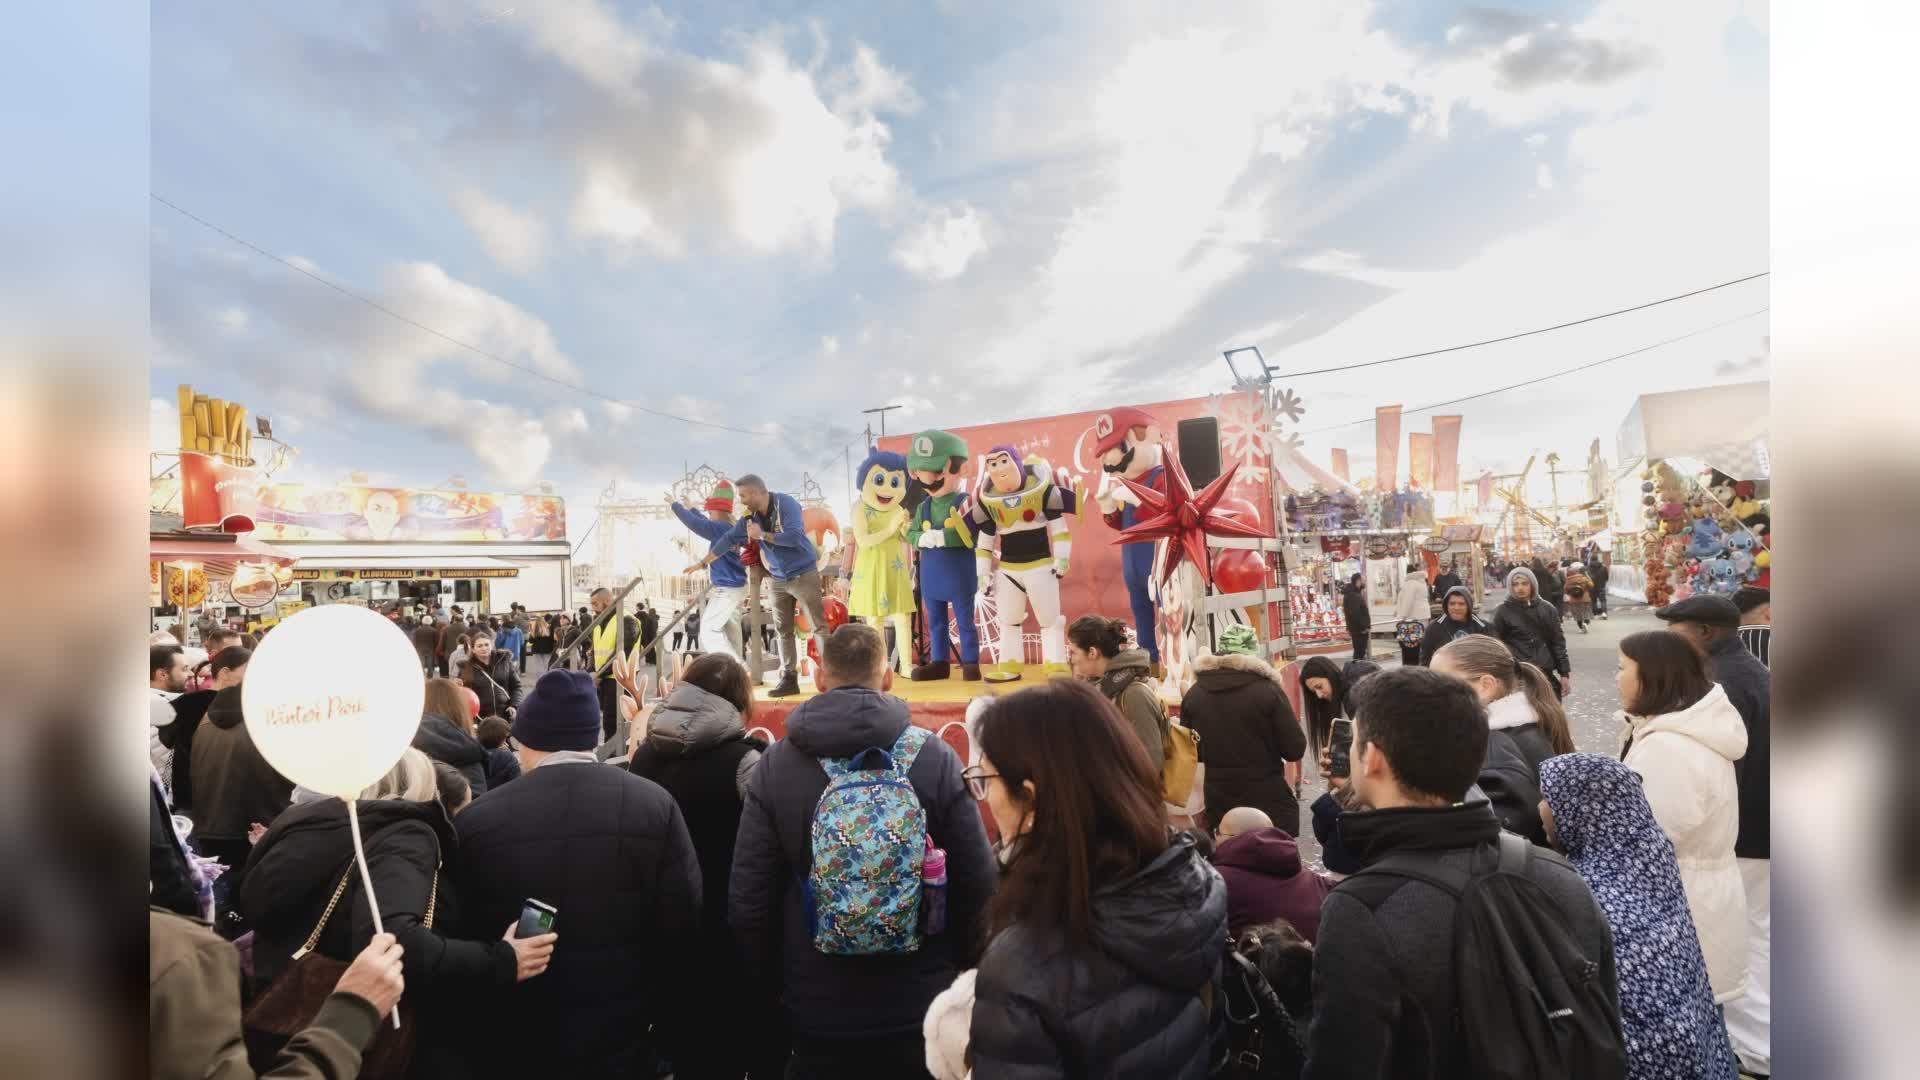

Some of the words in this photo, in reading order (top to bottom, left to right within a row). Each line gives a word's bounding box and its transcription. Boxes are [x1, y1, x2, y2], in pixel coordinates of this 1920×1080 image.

[919, 439, 929, 454] L
[265, 702, 322, 726] Winter
[327, 695, 369, 720] Park
